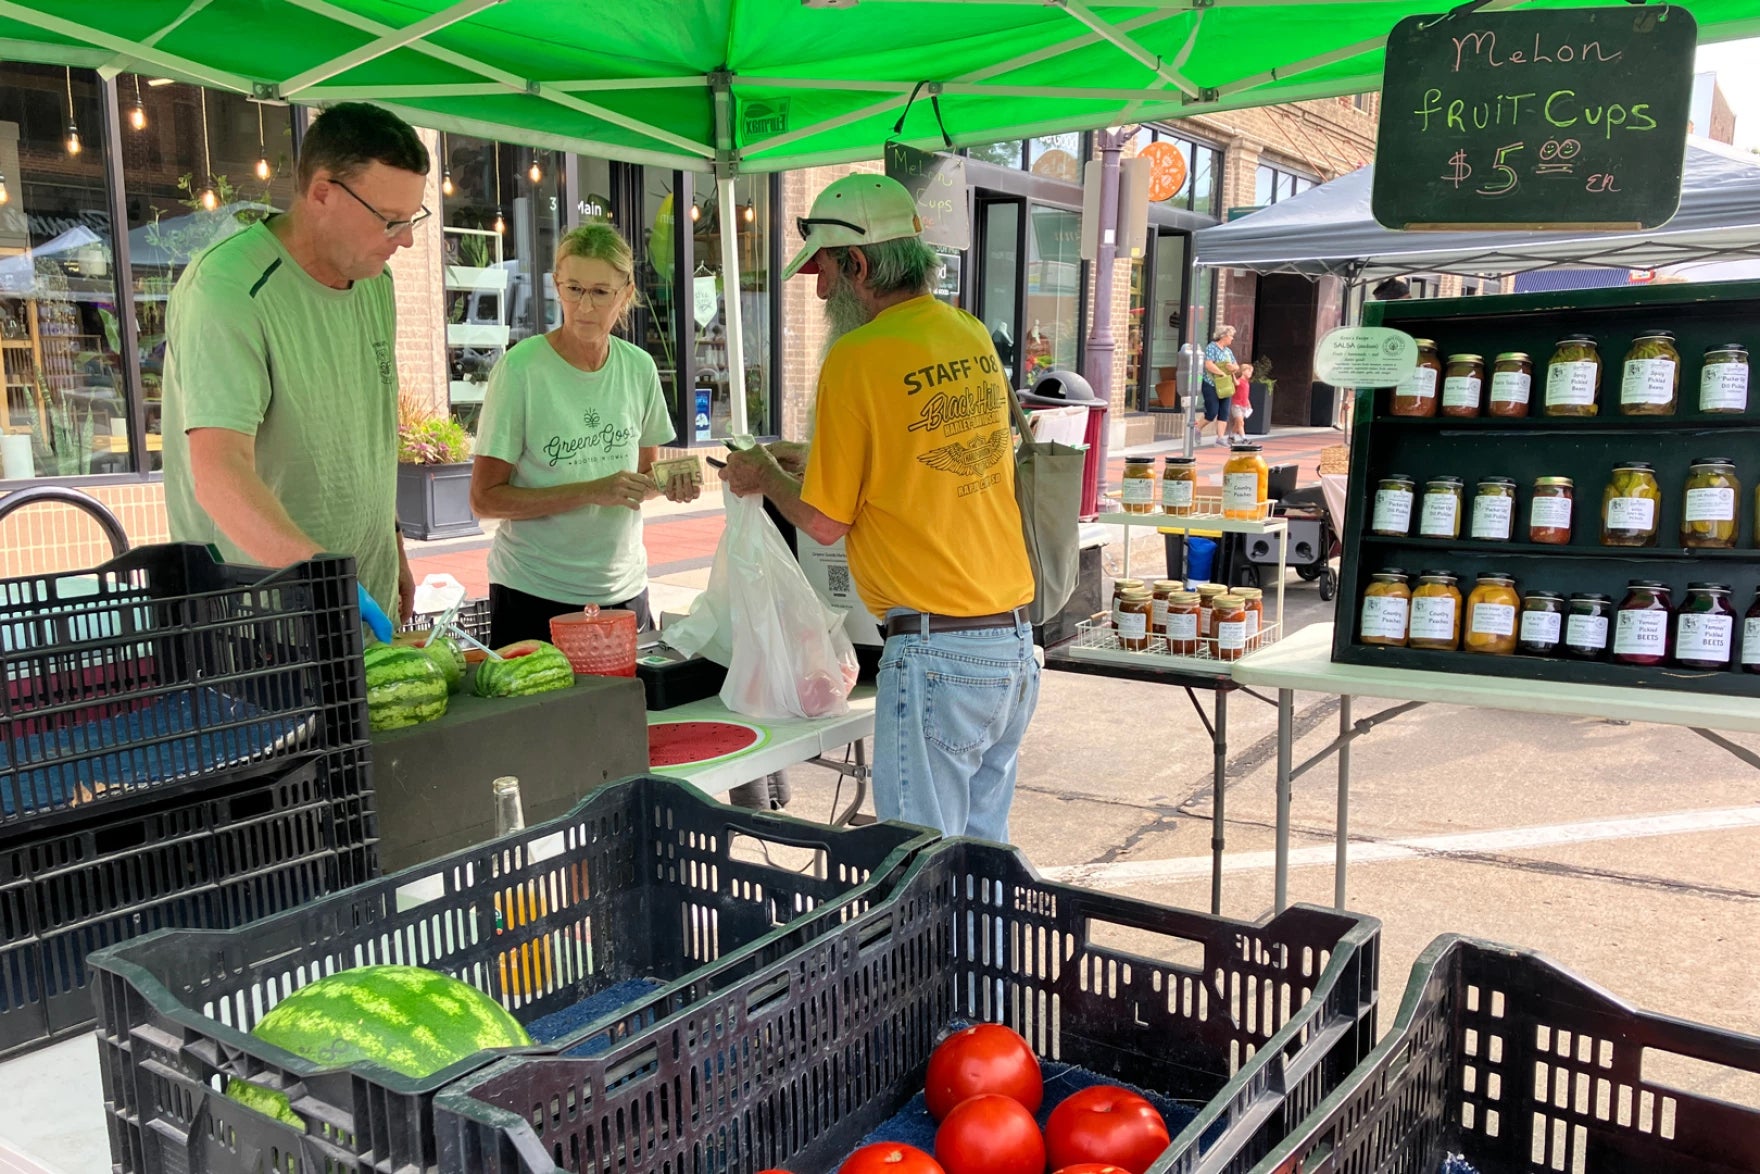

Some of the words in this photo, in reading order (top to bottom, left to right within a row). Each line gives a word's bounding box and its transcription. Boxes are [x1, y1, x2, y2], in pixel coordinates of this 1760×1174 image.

[1544, 90, 1657, 139] Cups
[903, 359, 972, 396] STAFF
[907, 386, 976, 433] Black
[543, 435, 601, 467] Greene
[1636, 633, 1659, 641] BEETS
[1702, 639, 1724, 647] BEETS
